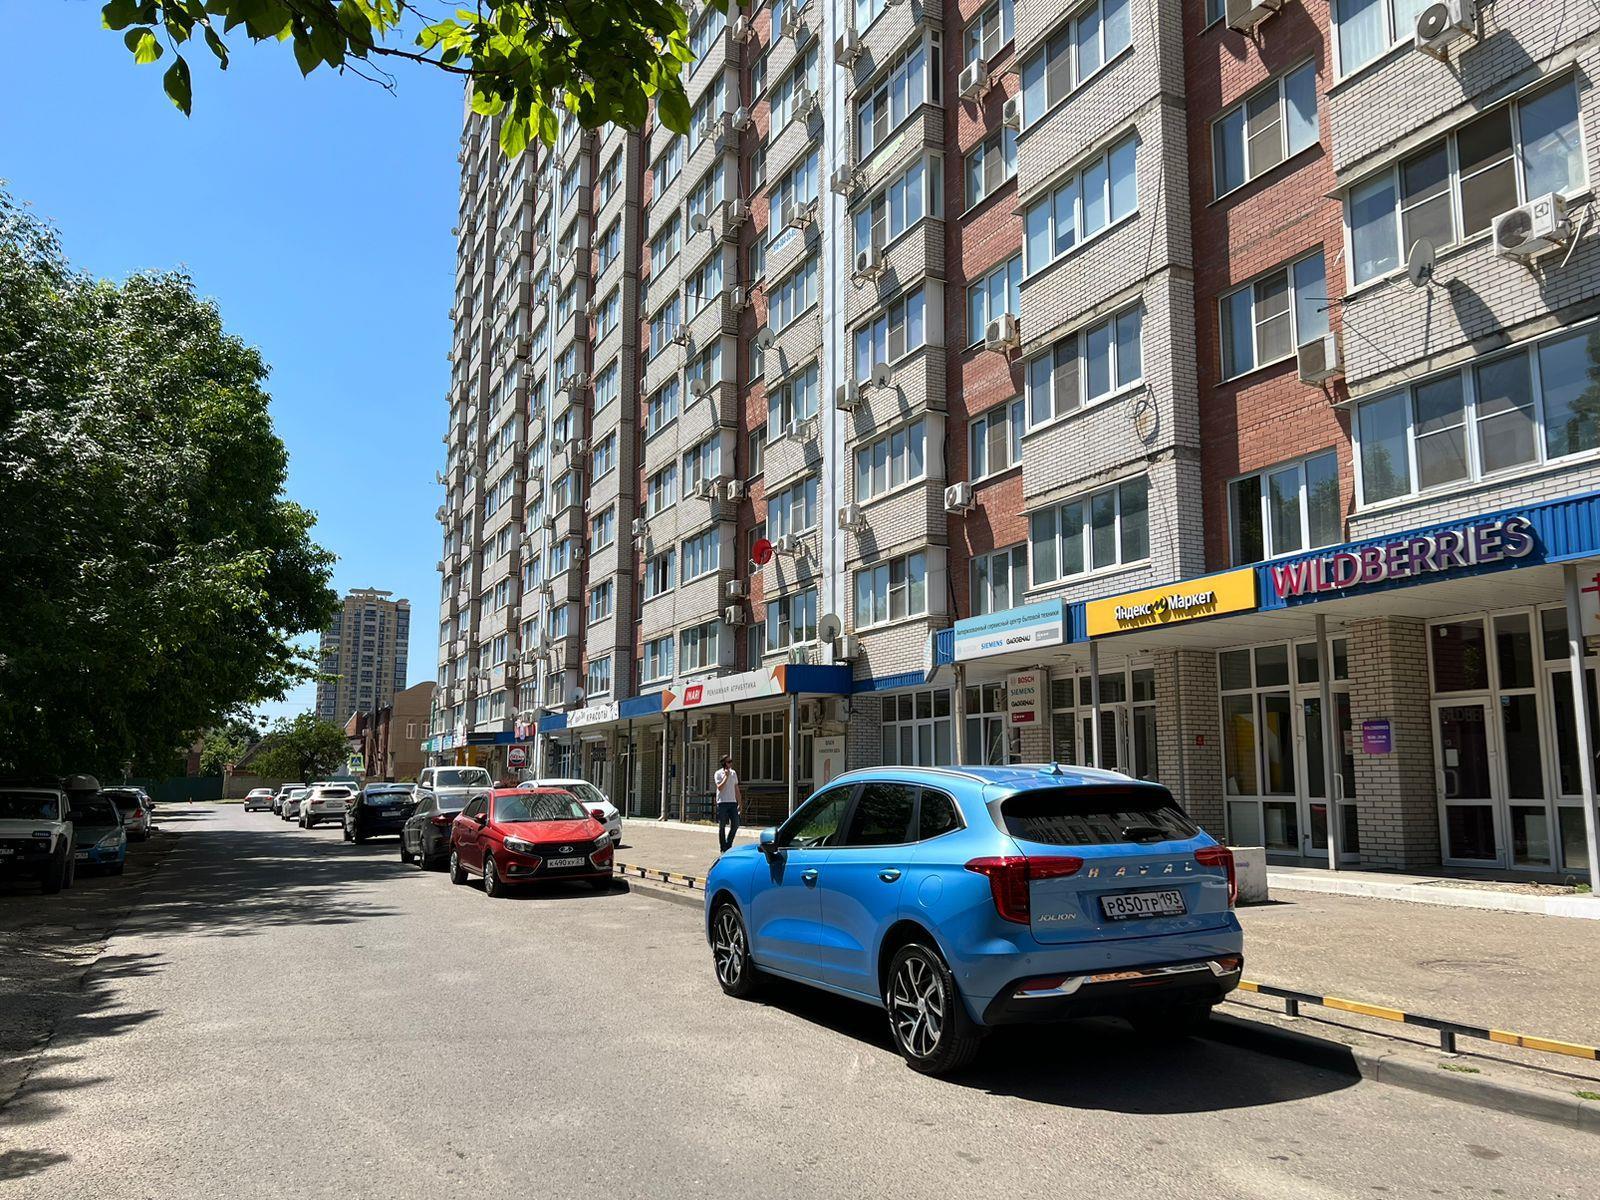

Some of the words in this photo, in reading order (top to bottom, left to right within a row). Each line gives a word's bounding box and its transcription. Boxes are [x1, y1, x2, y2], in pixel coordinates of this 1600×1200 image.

[1271, 516, 1534, 598] WILDBERRIES
[1114, 604, 1151, 620] Яндекс
[1168, 591, 1213, 611] Маркет
[981, 640, 1003, 650] SIEMENS
[1010, 687, 1035, 696] SIEMENS
[1088, 861, 1193, 878] HAVAL
[1160, 892, 1180, 905] 193
[1037, 912, 1077, 922] JOLION
